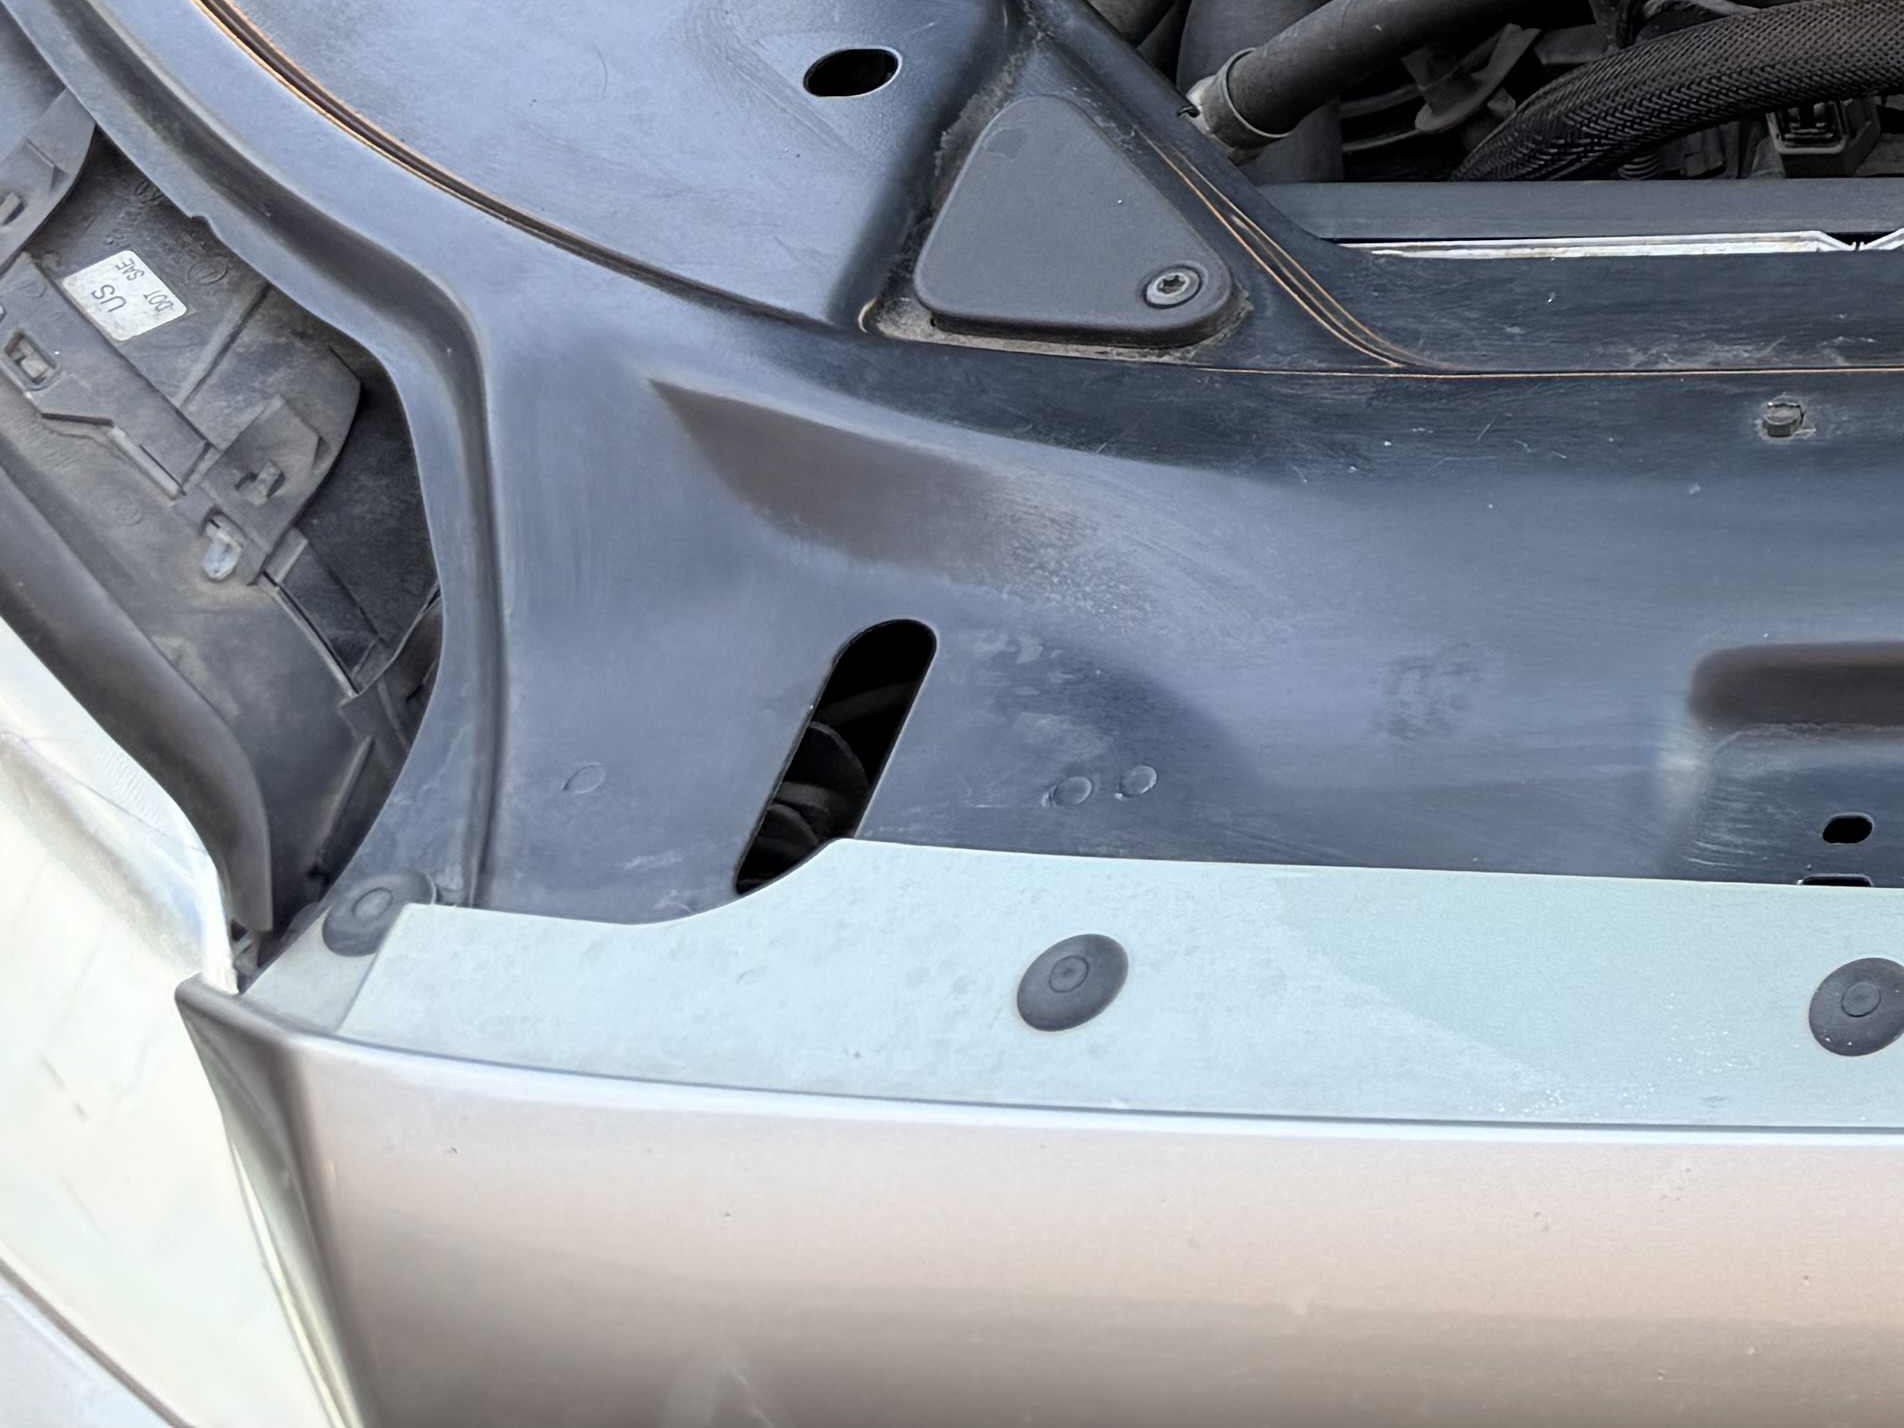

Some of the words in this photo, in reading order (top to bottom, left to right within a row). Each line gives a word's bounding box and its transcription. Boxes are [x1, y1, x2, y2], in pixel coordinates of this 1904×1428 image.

[115, 258, 145, 281] SAE
[90, 284, 127, 313] US
[143, 289, 174, 313] DOT
